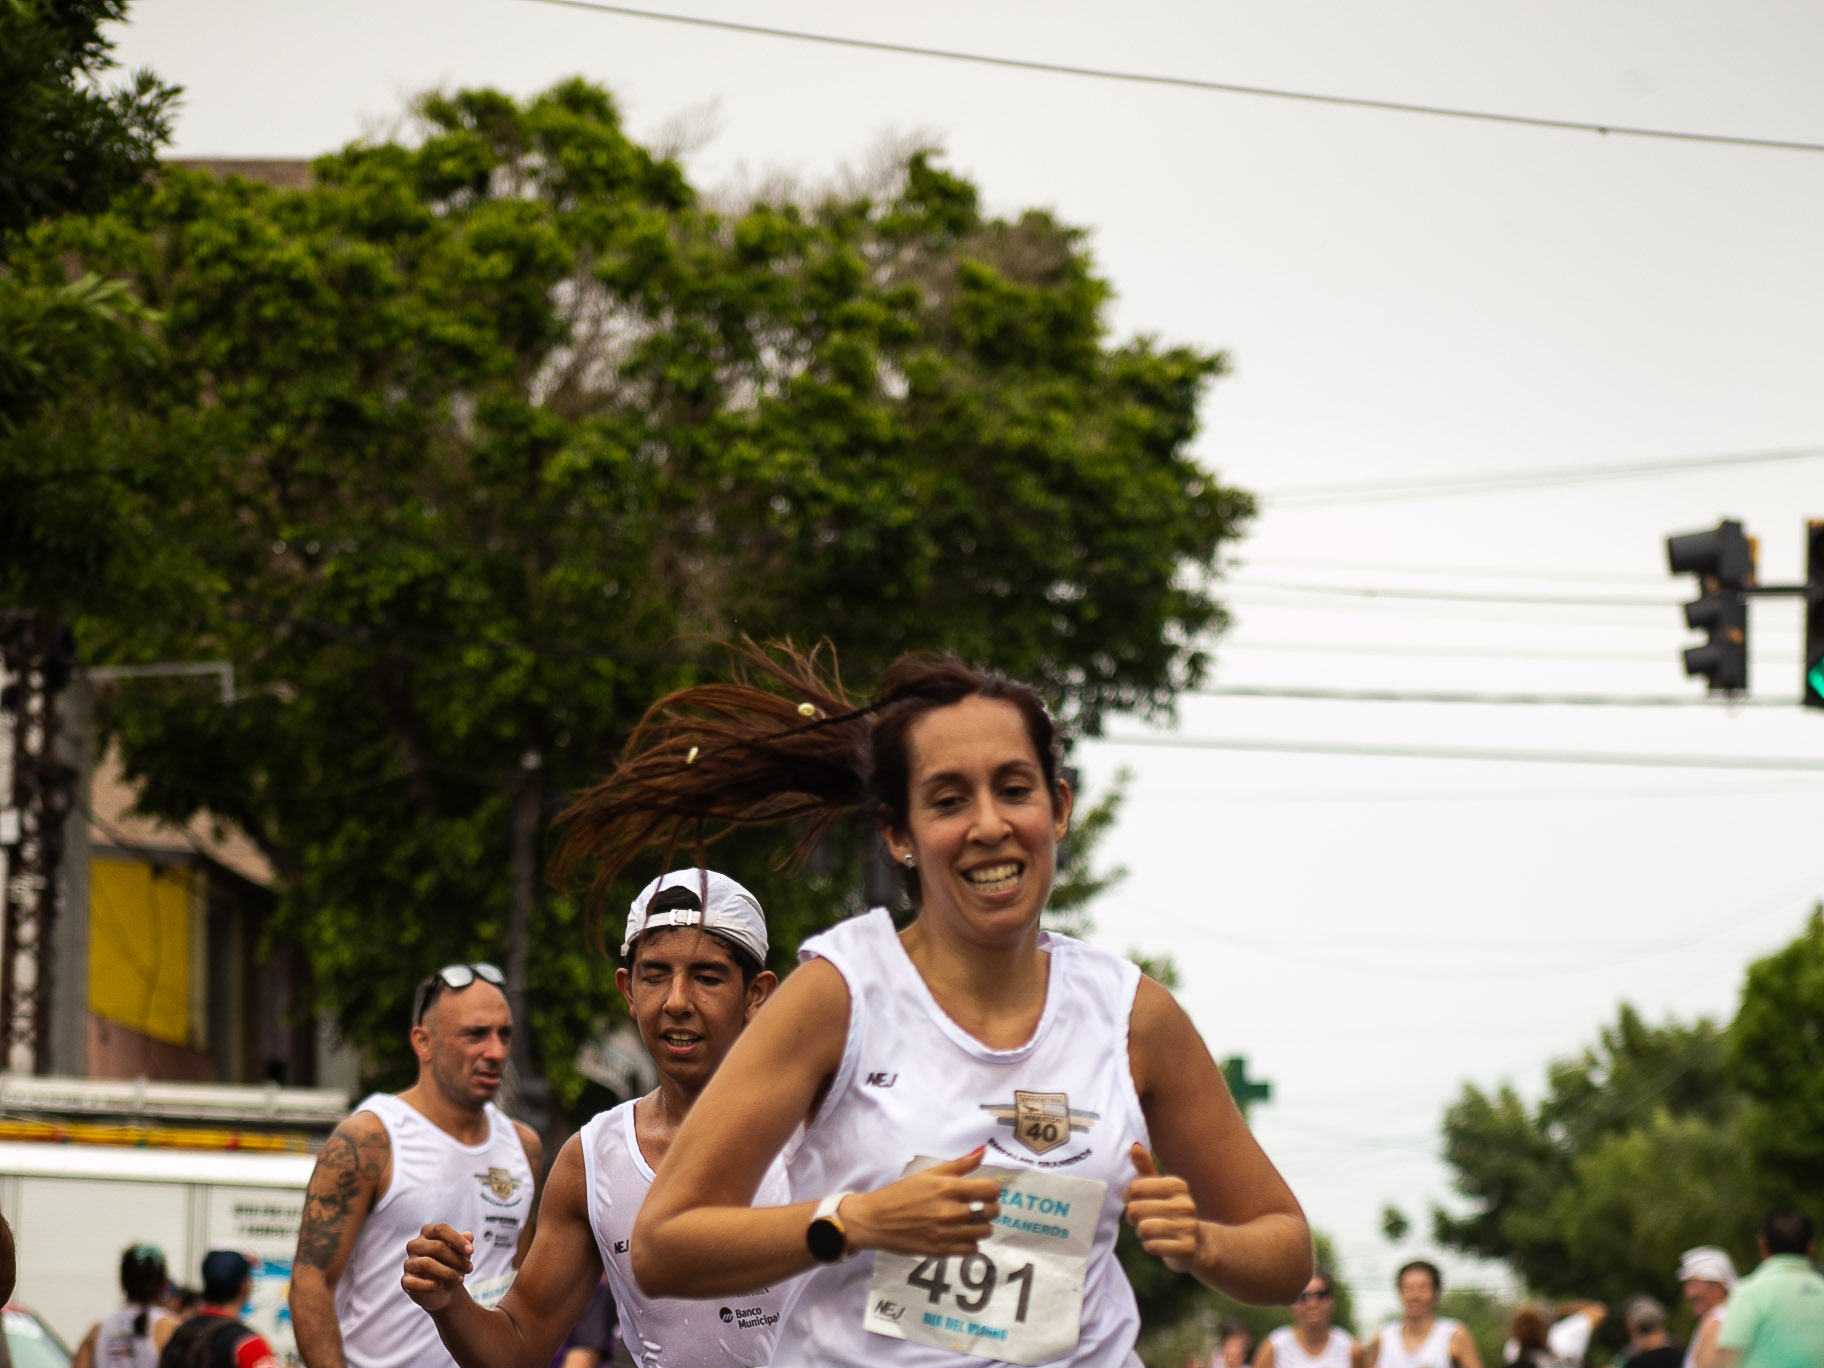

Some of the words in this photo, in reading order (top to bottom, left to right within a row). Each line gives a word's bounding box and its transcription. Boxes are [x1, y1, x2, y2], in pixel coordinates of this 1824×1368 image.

[1026, 1123, 1057, 1142] 40
[999, 1189, 1070, 1217] RATON
[907, 1252, 1034, 1323] 491
[735, 1307, 762, 1319] Banco
[874, 1300, 905, 1320] NEJ
[738, 1312, 780, 1329] Municipal
